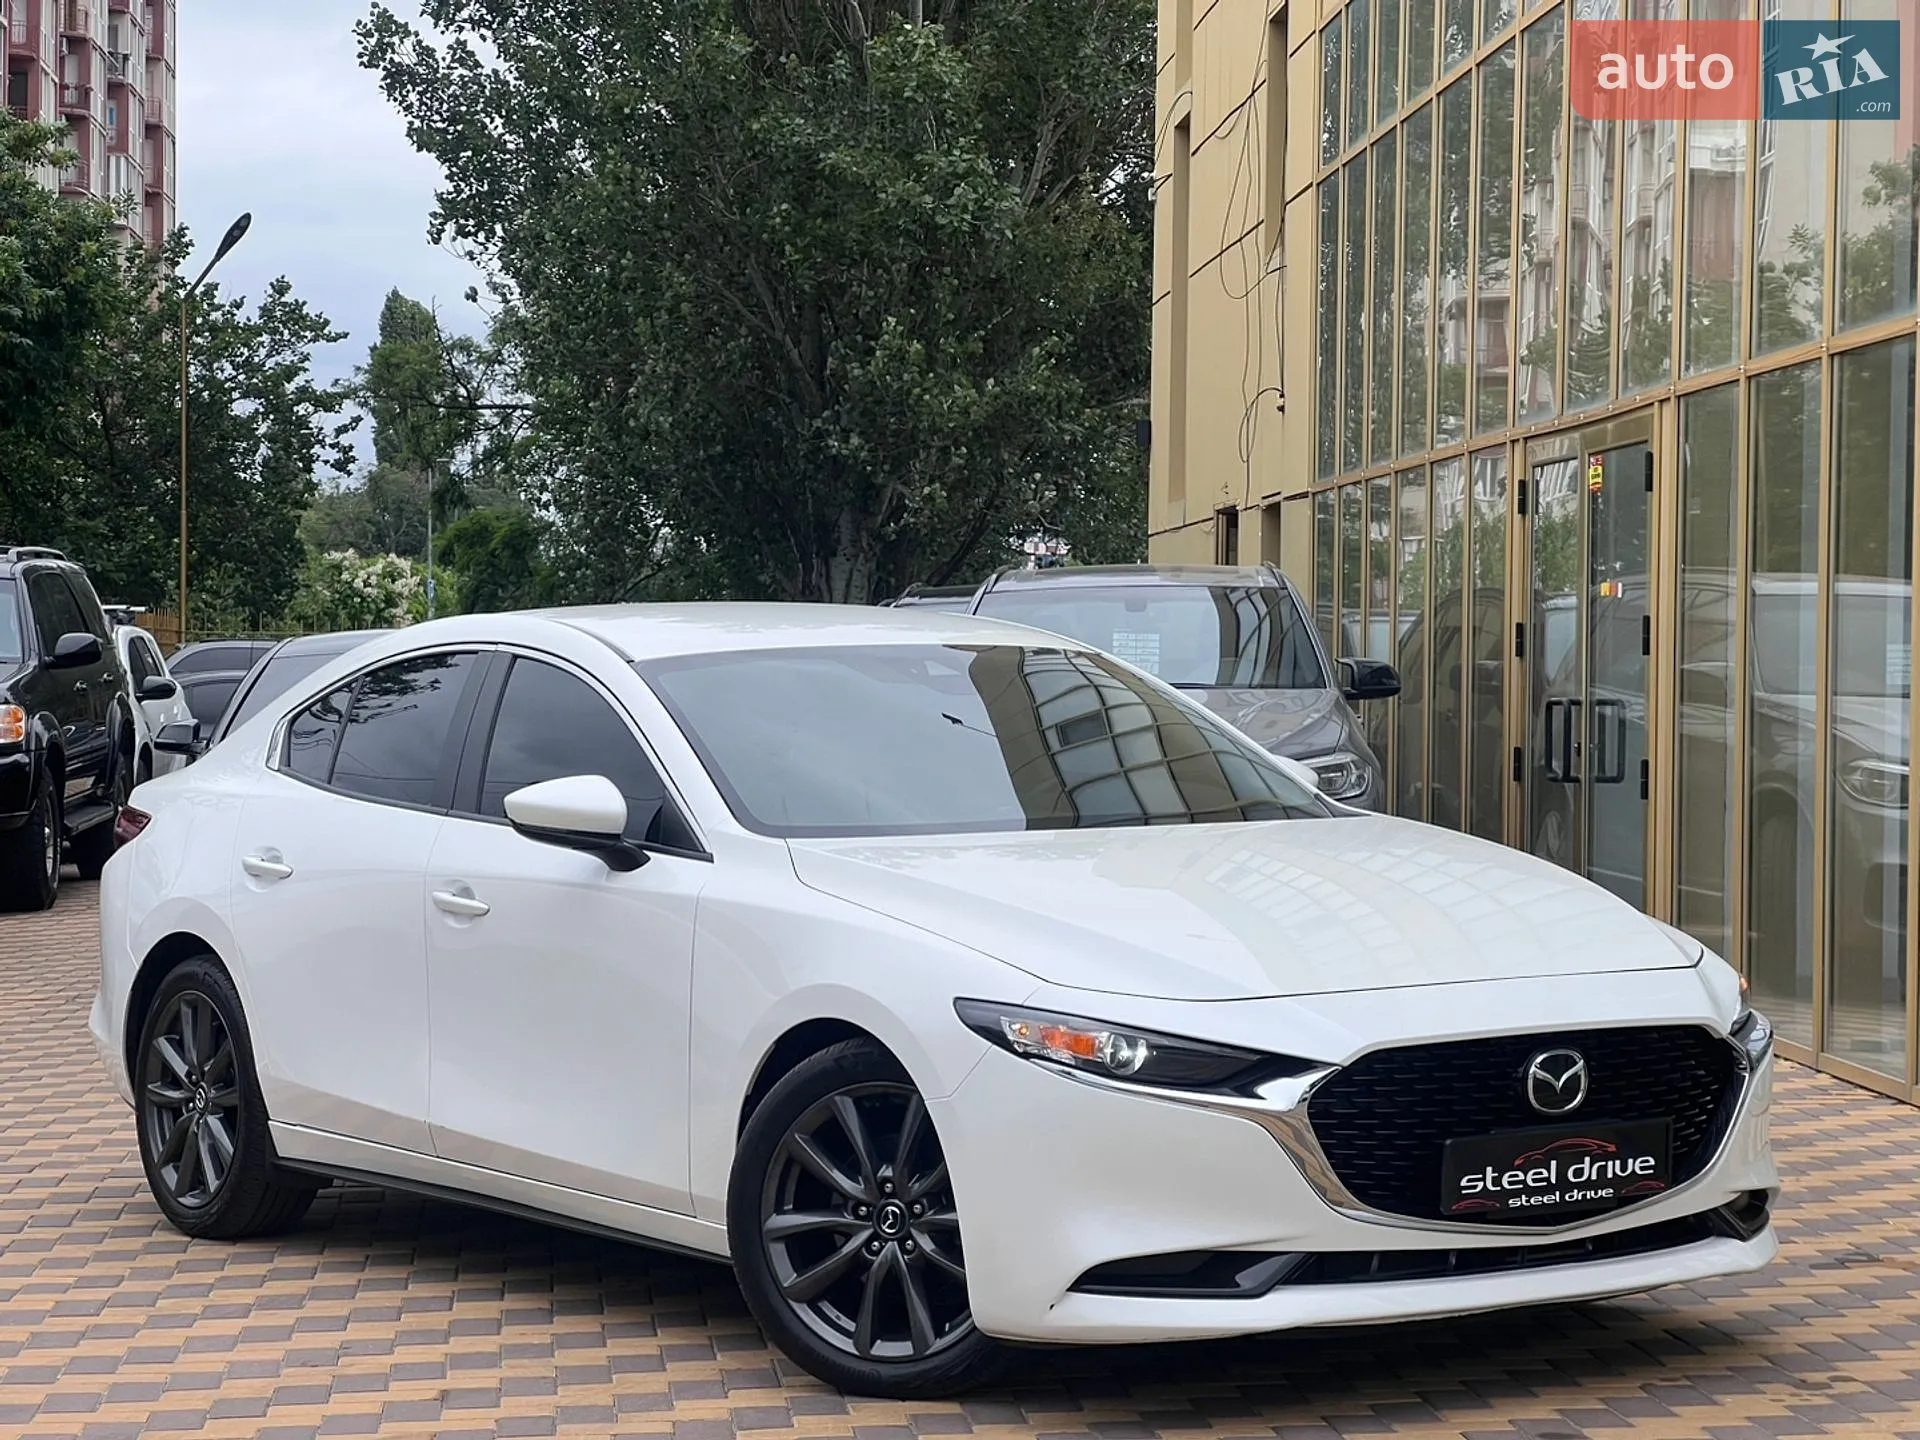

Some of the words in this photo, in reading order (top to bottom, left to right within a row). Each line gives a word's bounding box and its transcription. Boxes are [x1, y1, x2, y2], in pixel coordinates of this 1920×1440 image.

[1460, 1160, 1557, 1194] steel
[1567, 1156, 1655, 1183] drive
[1508, 1191, 1559, 1208] steel
[1565, 1187, 1614, 1202] drive
